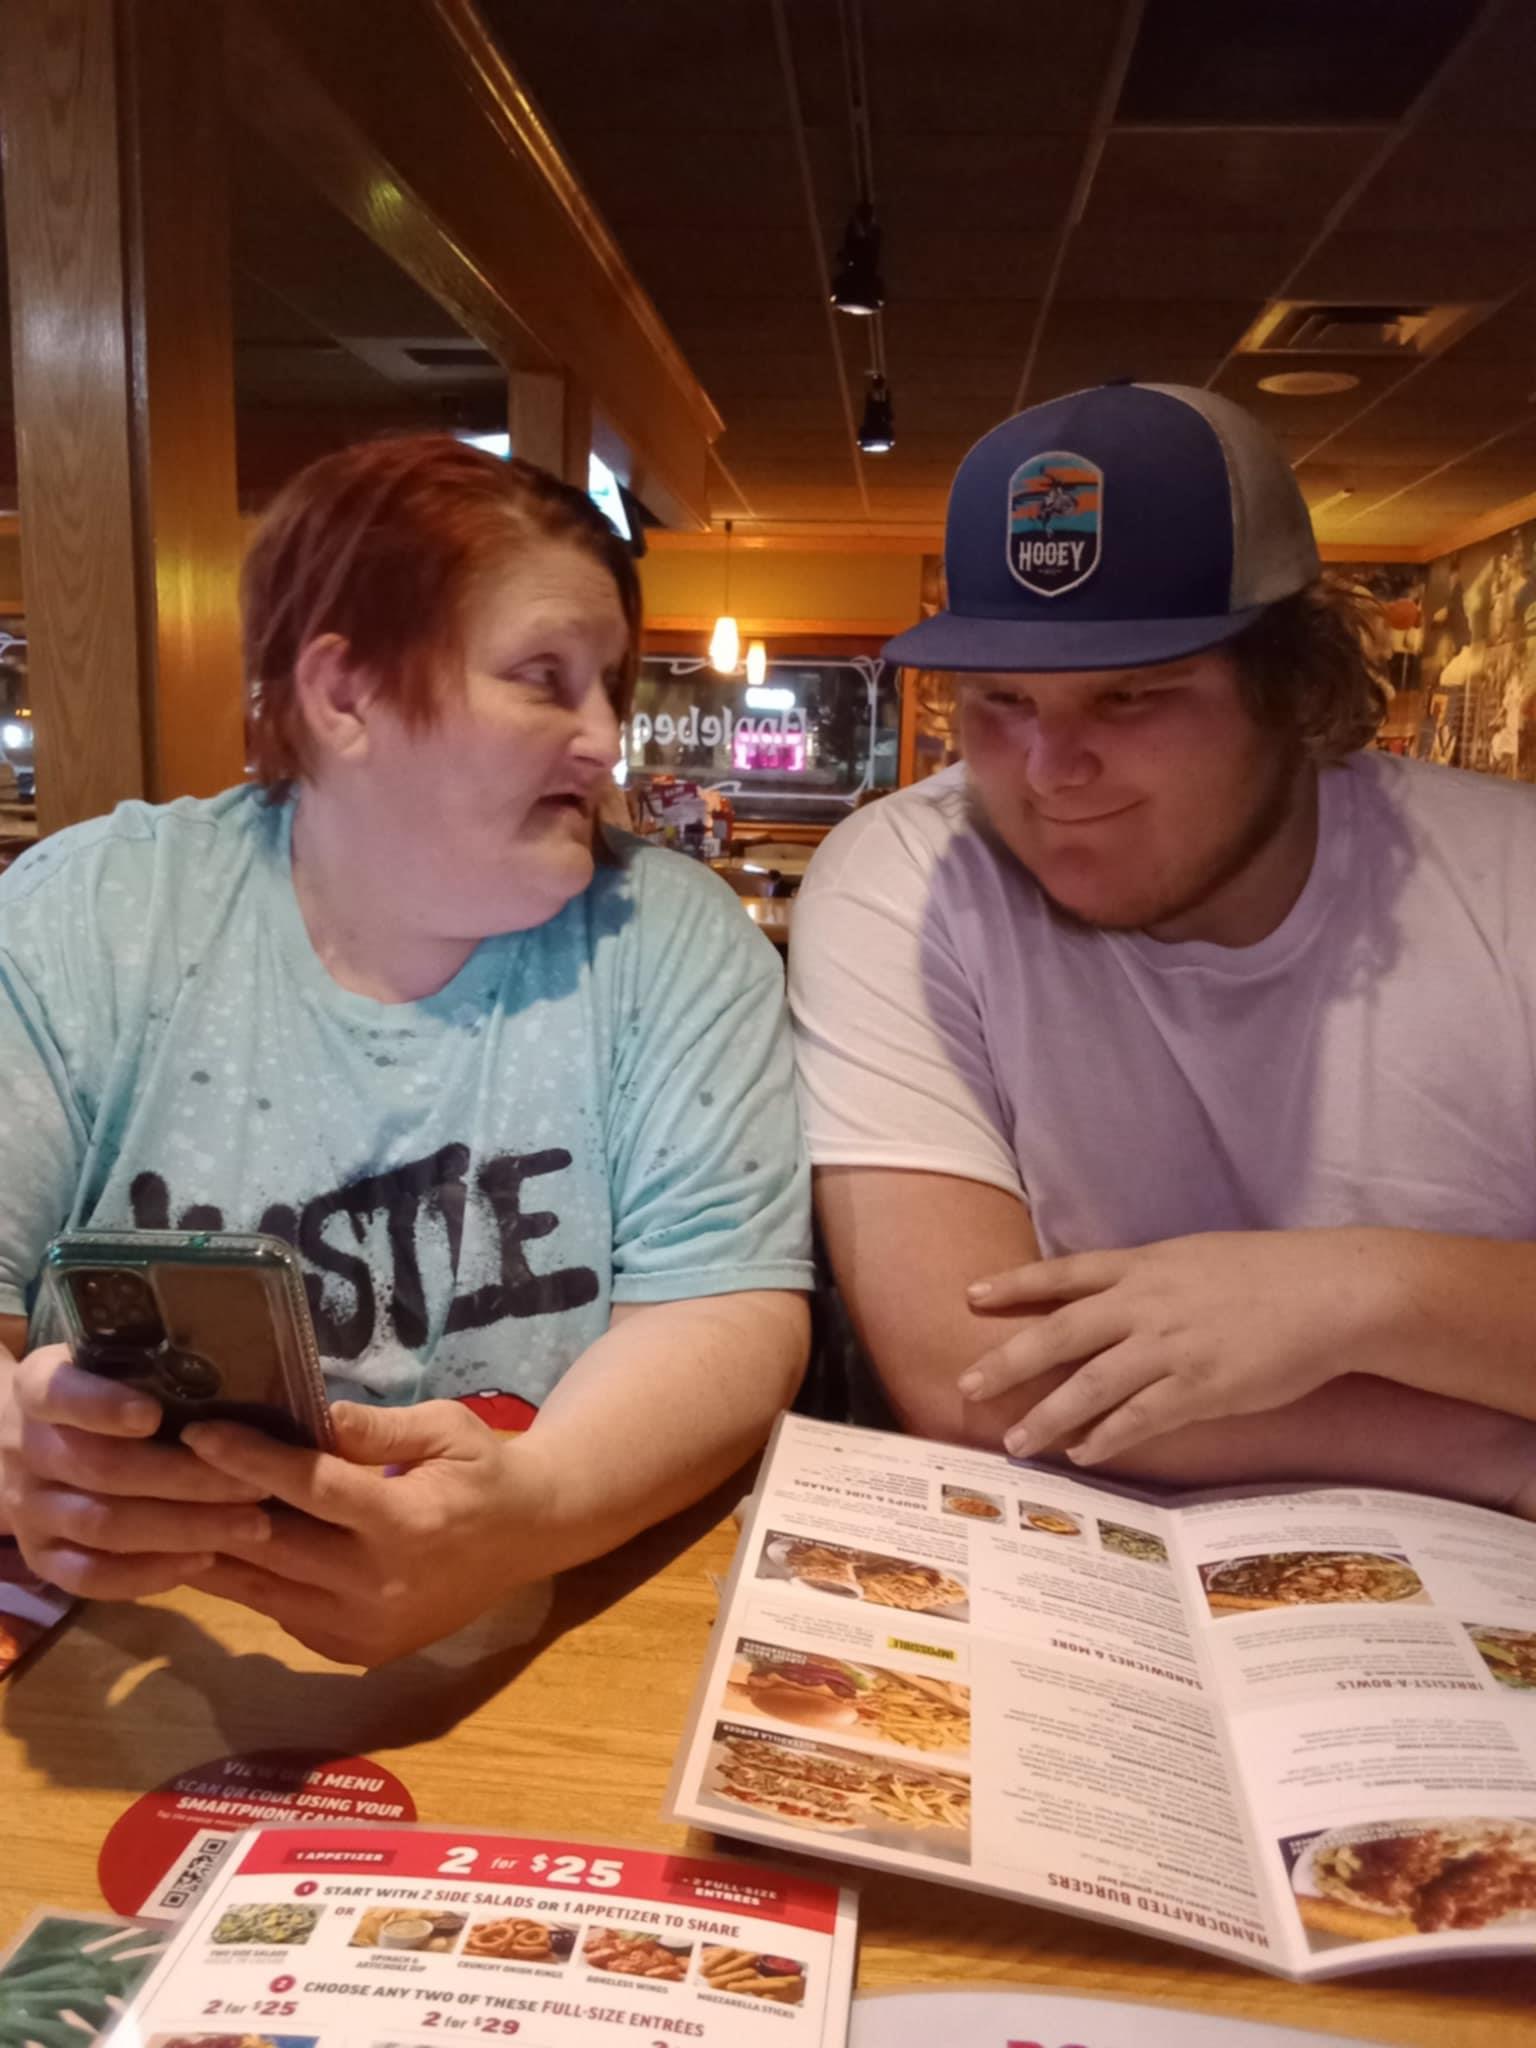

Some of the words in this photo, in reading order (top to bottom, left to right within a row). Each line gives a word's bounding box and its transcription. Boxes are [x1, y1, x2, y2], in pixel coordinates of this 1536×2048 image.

[1019, 541, 1085, 571] HOOEY
[1050, 1639, 1090, 1656] MORE
[1108, 1654, 1204, 1691] SANDWICHES
[324, 1773, 384, 1793] MENU
[174, 1779, 218, 1796] SCAN
[247, 1787, 295, 1805] CODE
[296, 1794, 352, 1813] USING
[355, 1801, 404, 1818] YOUR
[176, 1796, 302, 1823] SMARTPHONE
[304, 1852, 384, 1862] APPETIZER
[438, 1846, 479, 1874] 2
[490, 1857, 517, 1871] for
[530, 1853, 625, 1888] $25
[1047, 1873, 1132, 1906] BURGERS
[323, 1886, 371, 1897] START
[375, 1888, 418, 1899] WITH
[421, 1889, 431, 1900] 2
[434, 1890, 470, 1903] SIDE
[472, 1893, 533, 1908] SALADS
[537, 1901, 559, 1912] OR
[573, 1903, 660, 1925] APPETIZER
[664, 1915, 683, 1928] TO
[687, 1918, 740, 1938] SHARE
[335, 1906, 355, 1916] OR
[1137, 1897, 1269, 1949] HANDCRAFTED
[202, 2000, 223, 2015] 2
[225, 2001, 247, 2014] for
[252, 1999, 298, 2016] $25
[303, 1981, 371, 1997] CHOOSE
[372, 1985, 411, 1999] ANY
[415, 1988, 454, 2003] TWO
[457, 1992, 482, 2006] OF
[485, 1995, 539, 2012] THESE
[542, 2000, 626, 2024] FULL-SIZE
[629, 2012, 705, 2037] ENTRÉES
[421, 2011, 441, 2027] 2
[444, 2015, 467, 2029] for
[473, 2016, 521, 2035] $29
